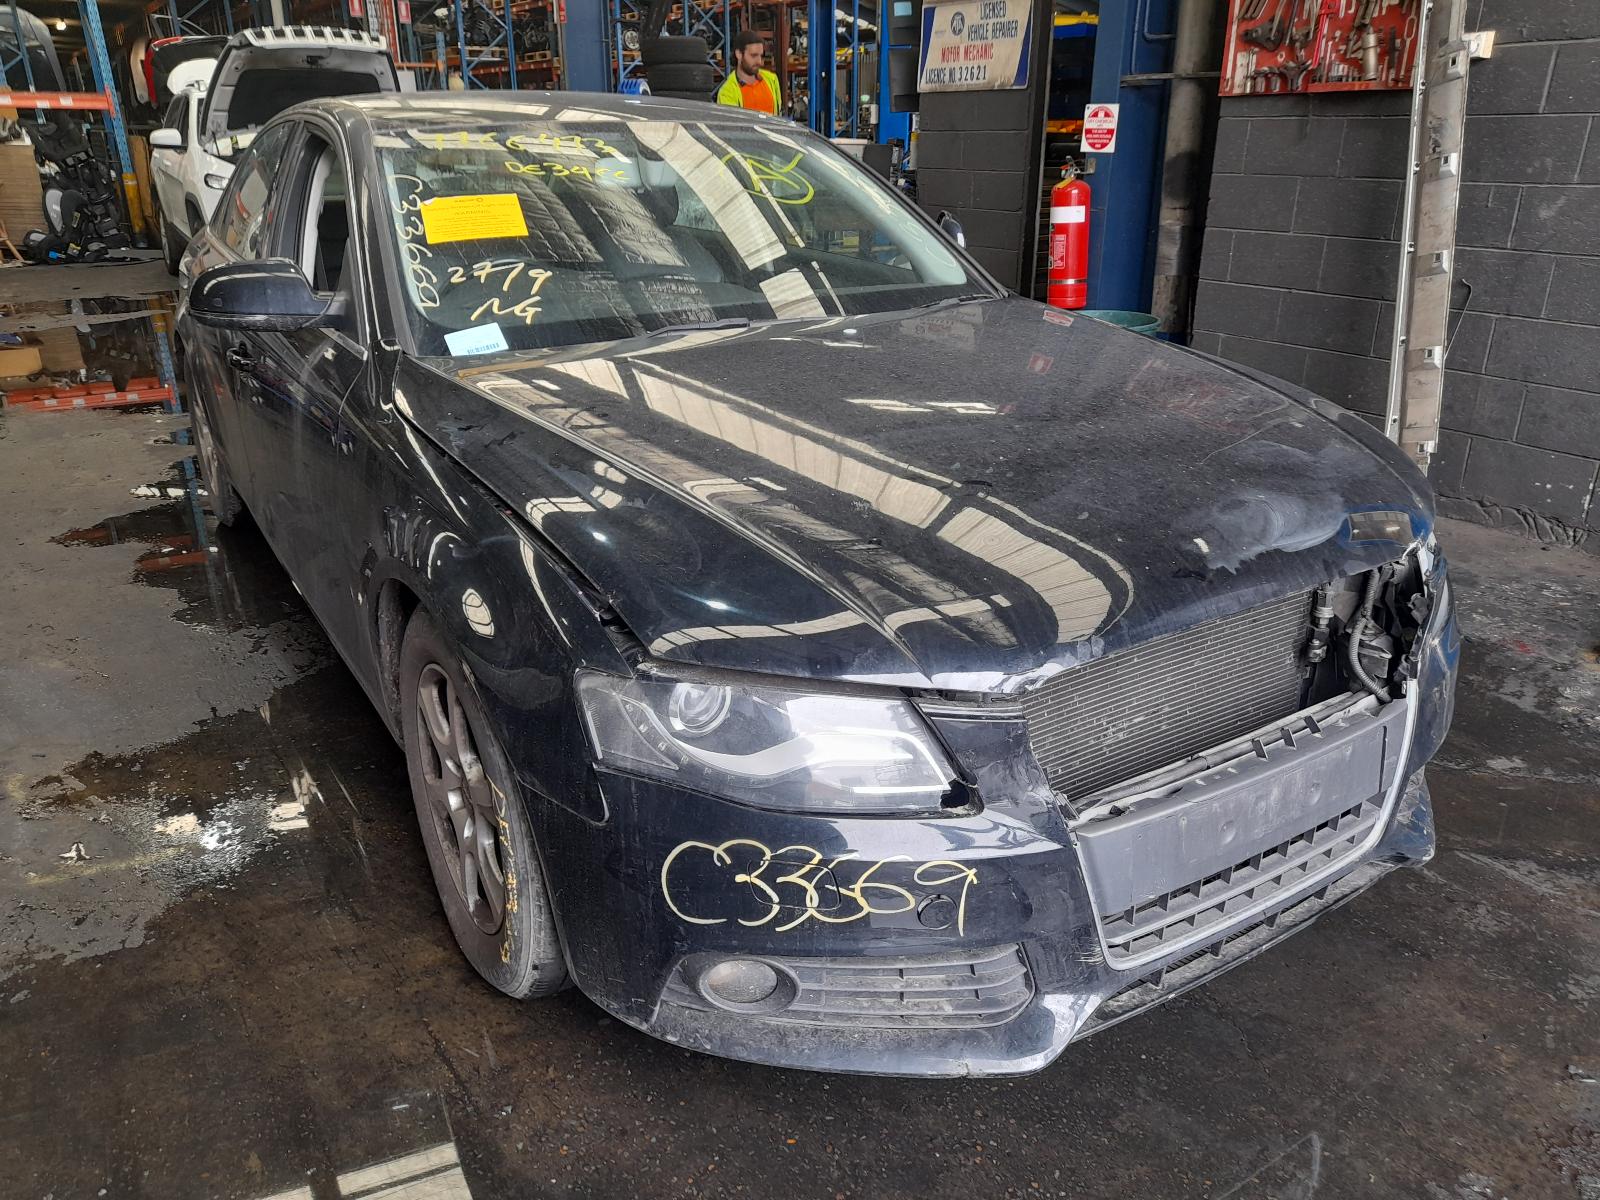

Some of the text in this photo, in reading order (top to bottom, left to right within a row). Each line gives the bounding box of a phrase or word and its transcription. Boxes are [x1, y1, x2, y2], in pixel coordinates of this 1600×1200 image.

[980, 1, 1006, 20] LICENSED
[967, 23, 989, 41] VEHICLE
[991, 20, 1018, 39] REPAIRER
[941, 43, 994, 63] MOTOR MECHANIC
[925, 67, 946, 84] LICENCE
[958, 64, 987, 82] 32621
[391, 174, 440, 307] C33669
[661, 838, 978, 937] C33669
